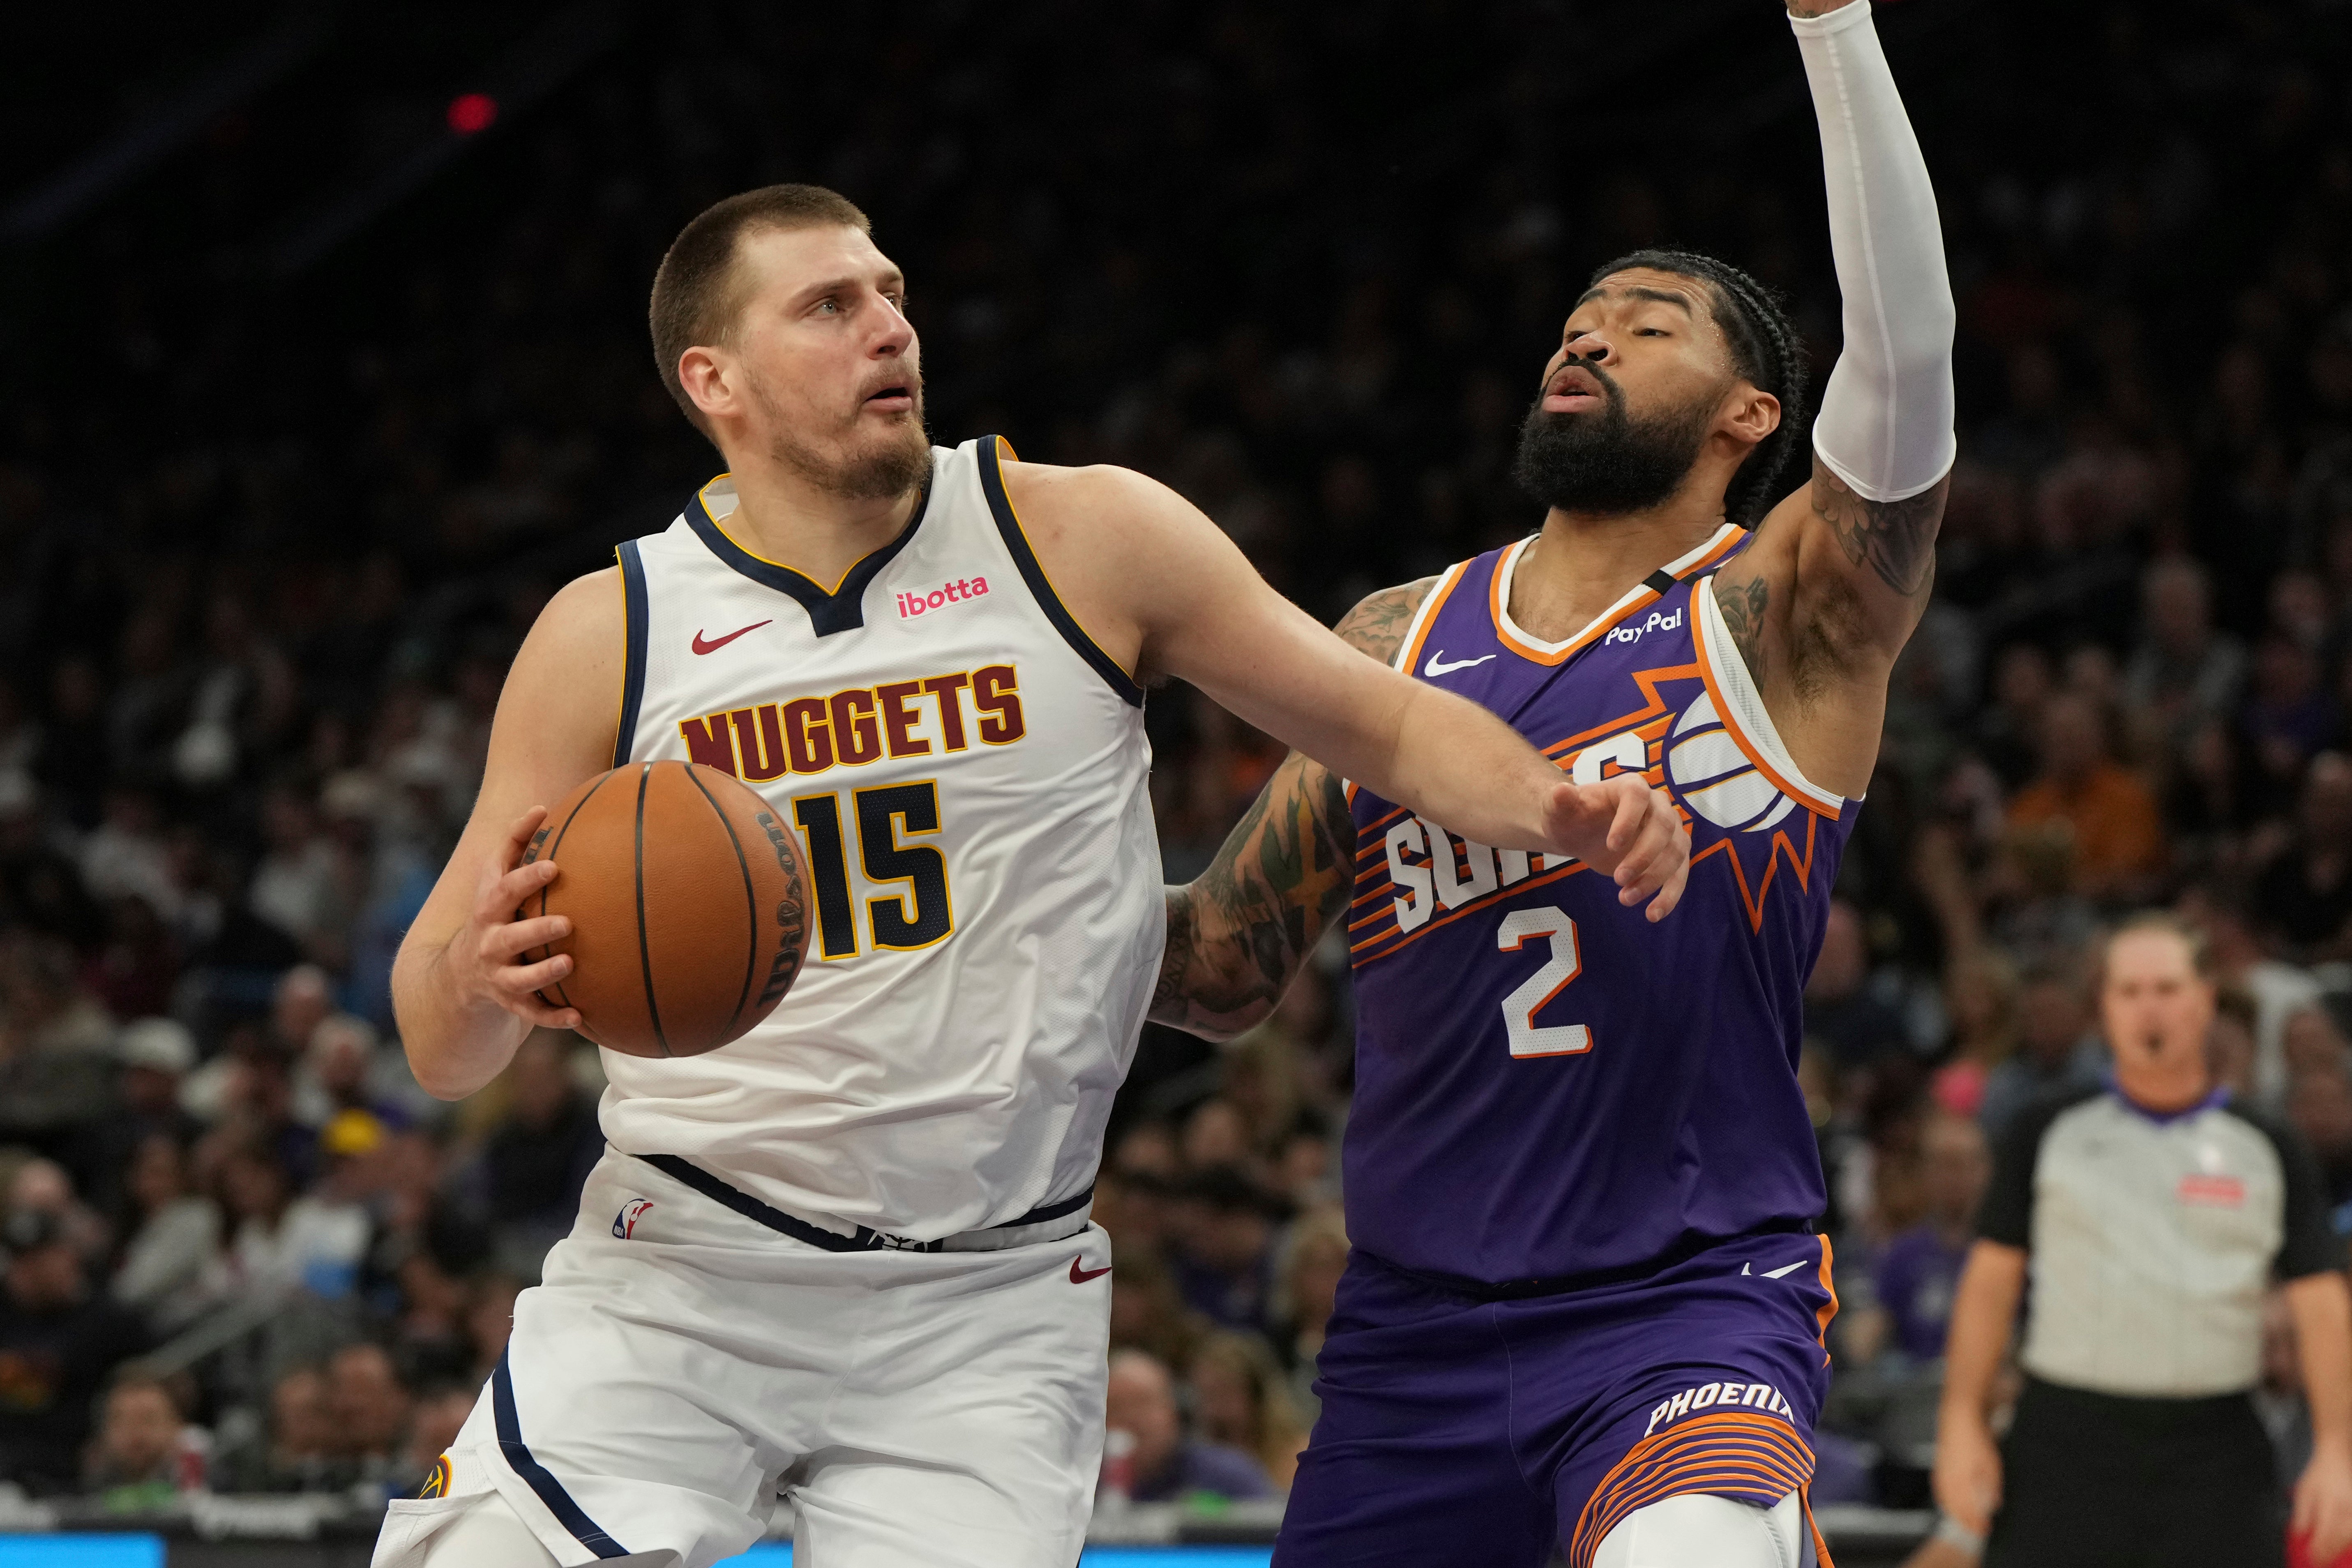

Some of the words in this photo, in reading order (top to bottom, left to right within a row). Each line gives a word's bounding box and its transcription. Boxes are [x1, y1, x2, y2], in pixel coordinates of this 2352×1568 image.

[897, 577, 989, 618] ibotta
[1605, 607, 1681, 646] PayPal
[678, 663, 1026, 783] NUGGETS
[791, 779, 955, 962] 15
[1498, 906, 1593, 1059] 2
[613, 1225, 624, 1237] NBA
